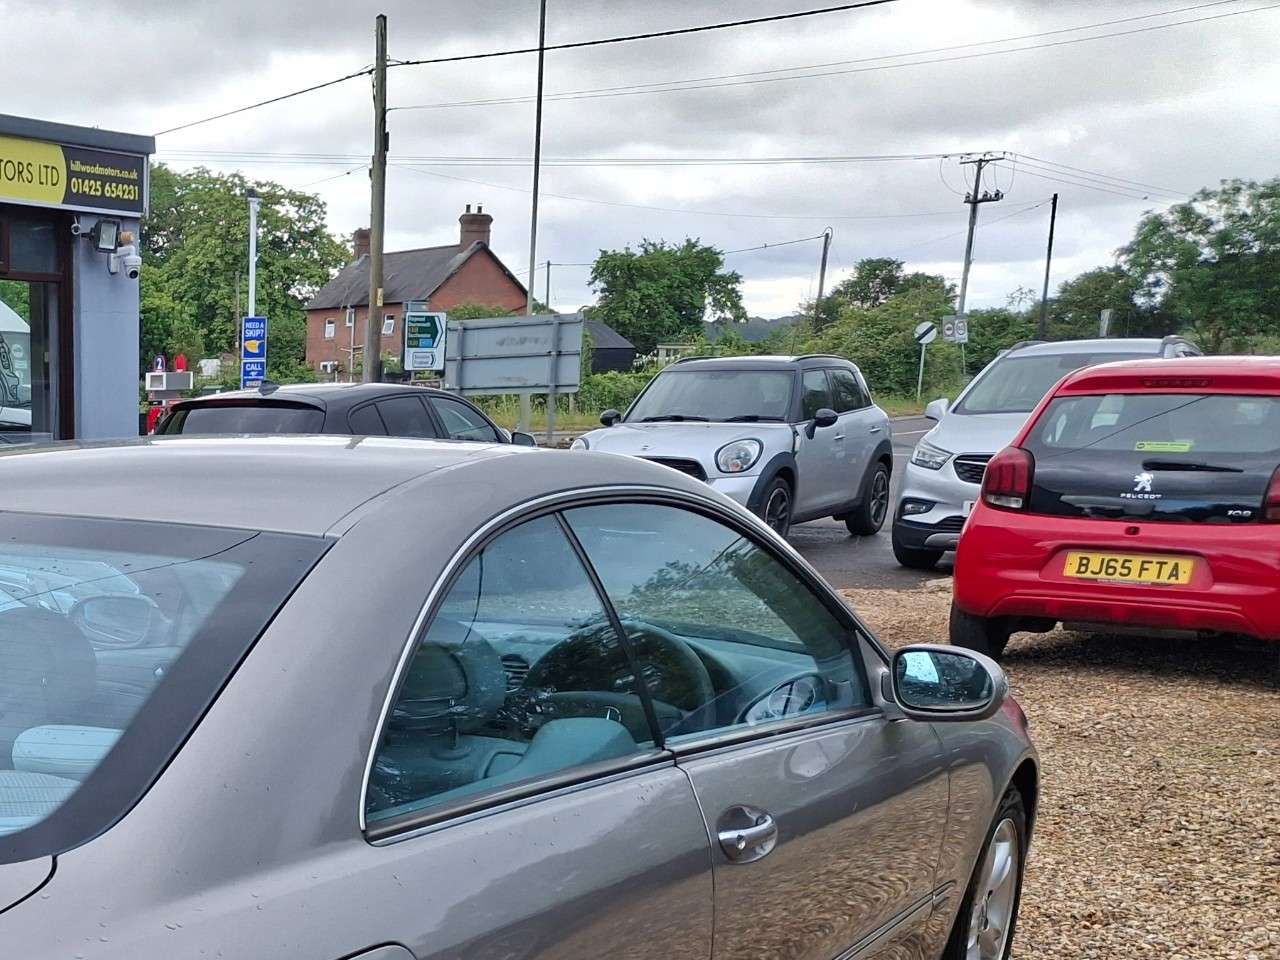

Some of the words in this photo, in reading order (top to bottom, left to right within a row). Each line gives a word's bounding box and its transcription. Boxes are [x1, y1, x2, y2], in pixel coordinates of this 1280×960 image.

[38, 163, 60, 187] LTD
[70, 159, 138, 180] hillwoodmotors.co.uk
[70, 177, 102, 197] 01425
[104, 182, 139, 200] 654231
[245, 321, 260, 329] NEED
[245, 329, 264, 338] SKIP?
[245, 363, 262, 371] CALL
[1075, 556, 1133, 578] BJ65
[1137, 560, 1180, 581] FTA
